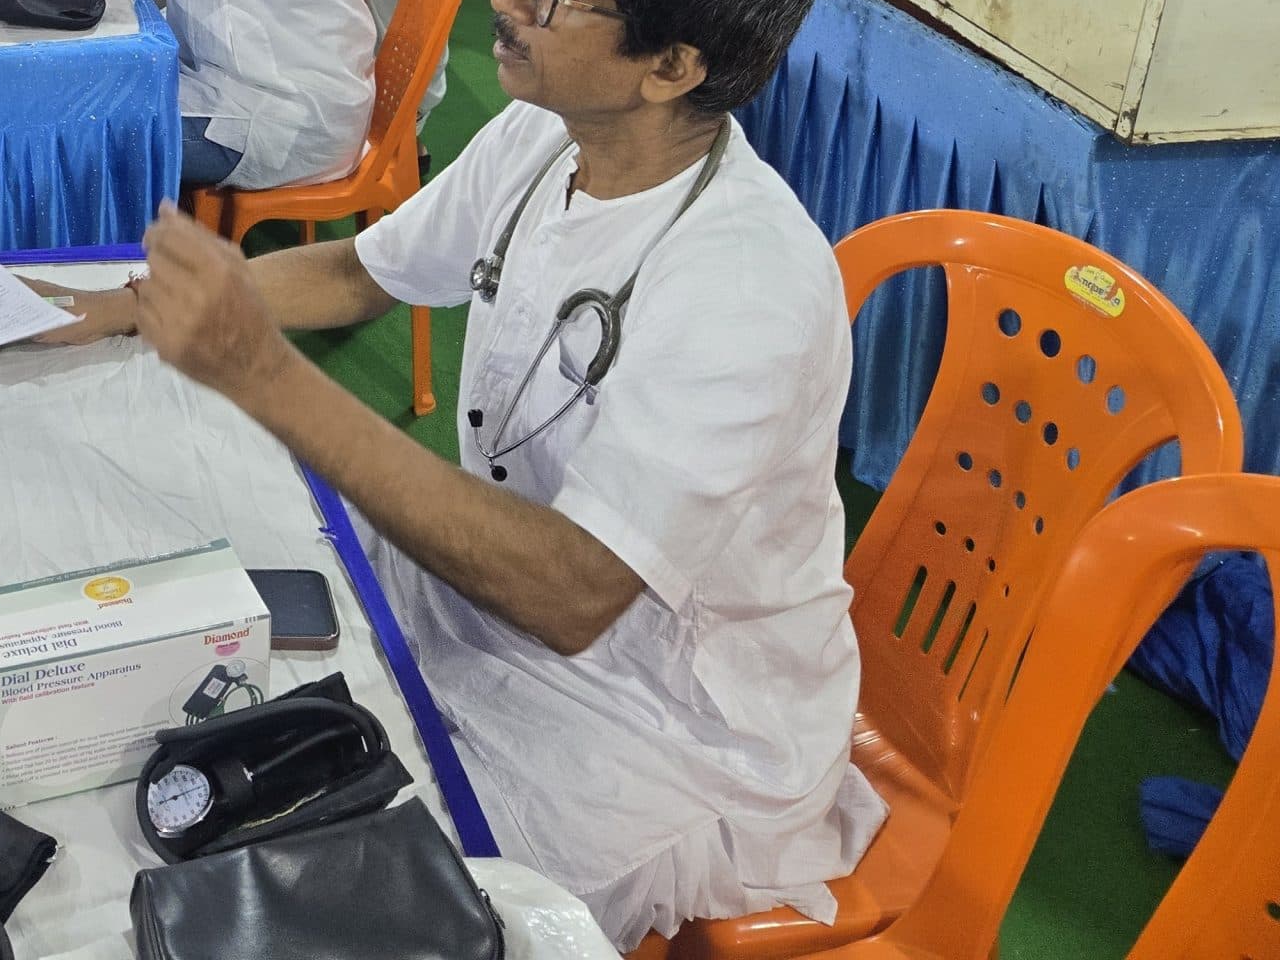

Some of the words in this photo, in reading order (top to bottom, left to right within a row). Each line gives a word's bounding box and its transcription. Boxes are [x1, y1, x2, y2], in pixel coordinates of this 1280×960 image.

[51, 625, 94, 639] Pressure
[95, 620, 123, 630] Blood
[0, 634, 48, 650] Apparatus
[53, 638, 78, 652] Dial
[203, 628, 250, 646] Diamond
[3, 643, 49, 659] Deluxe
[1, 671, 30, 687] Dial
[35, 662, 86, 681] Deluxe
[1, 683, 33, 698] Blood
[37, 675, 84, 691] Pressure
[87, 664, 142, 681] Apparatus
[35, 687, 70, 699] calibration
[71, 682, 96, 692] feature
